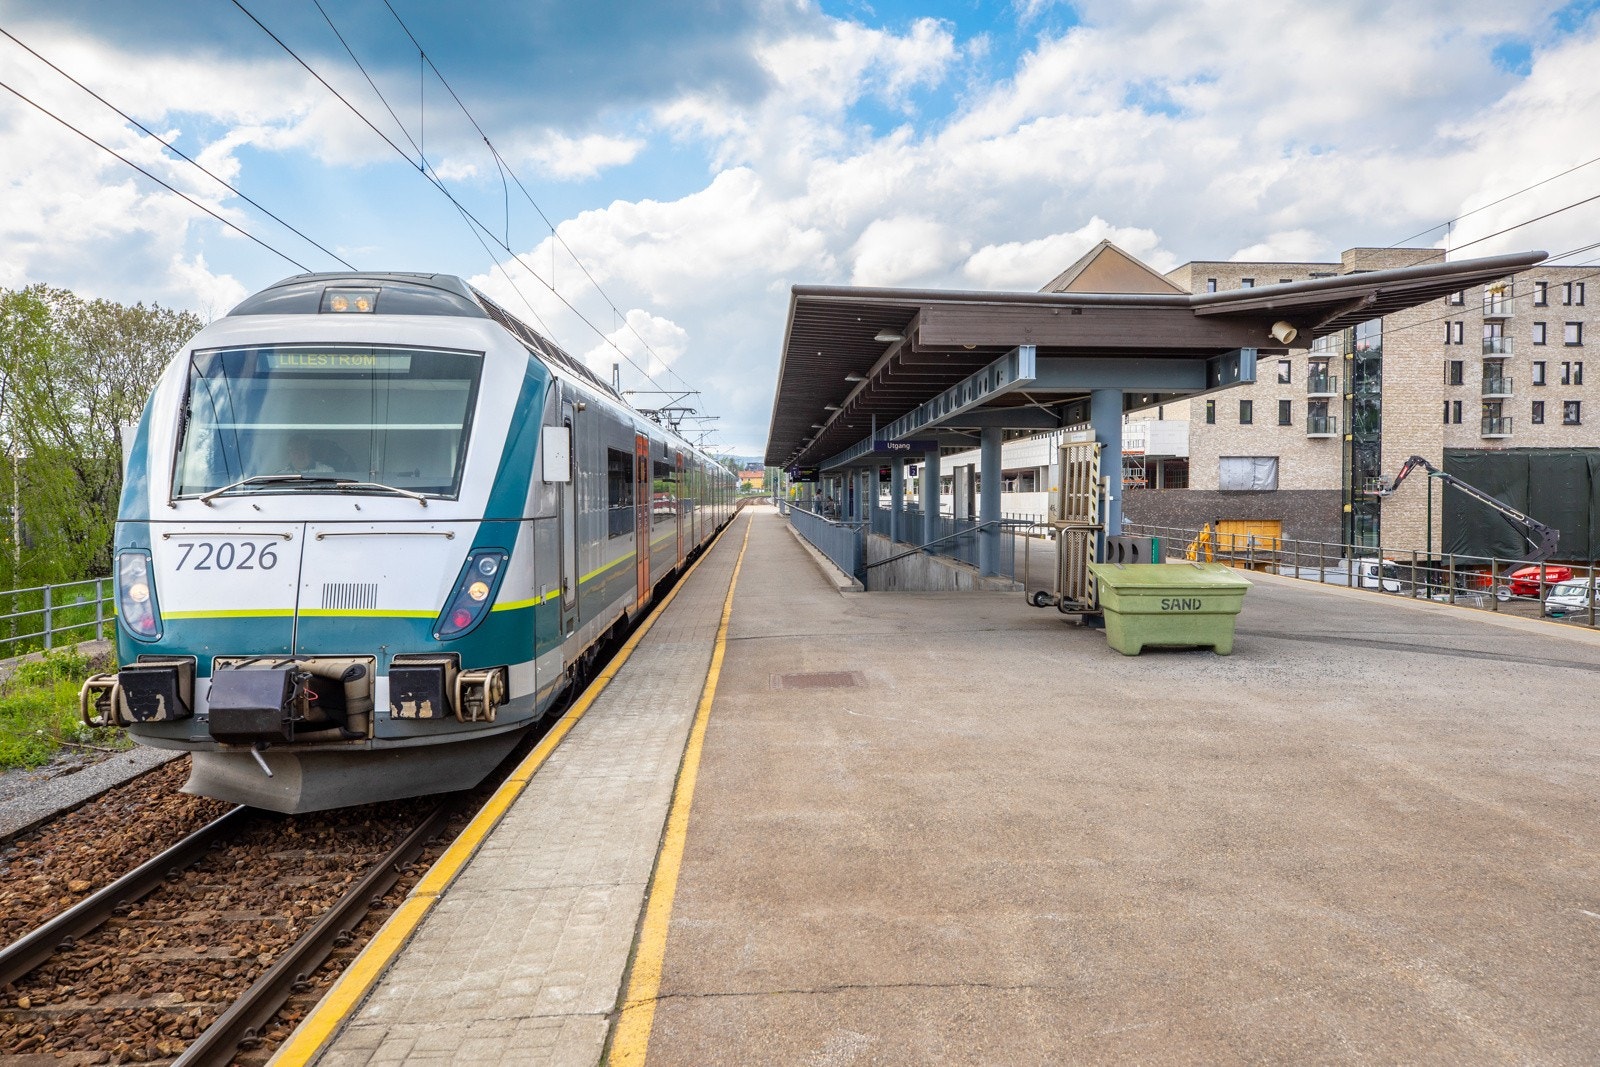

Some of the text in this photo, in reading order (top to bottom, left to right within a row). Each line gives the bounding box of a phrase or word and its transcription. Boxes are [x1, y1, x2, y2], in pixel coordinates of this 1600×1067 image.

[280, 354, 376, 366] LILLESTRØM
[887, 442, 910, 450] Utgang
[175, 542, 278, 571] 72026
[1161, 598, 1202, 611] SAND
